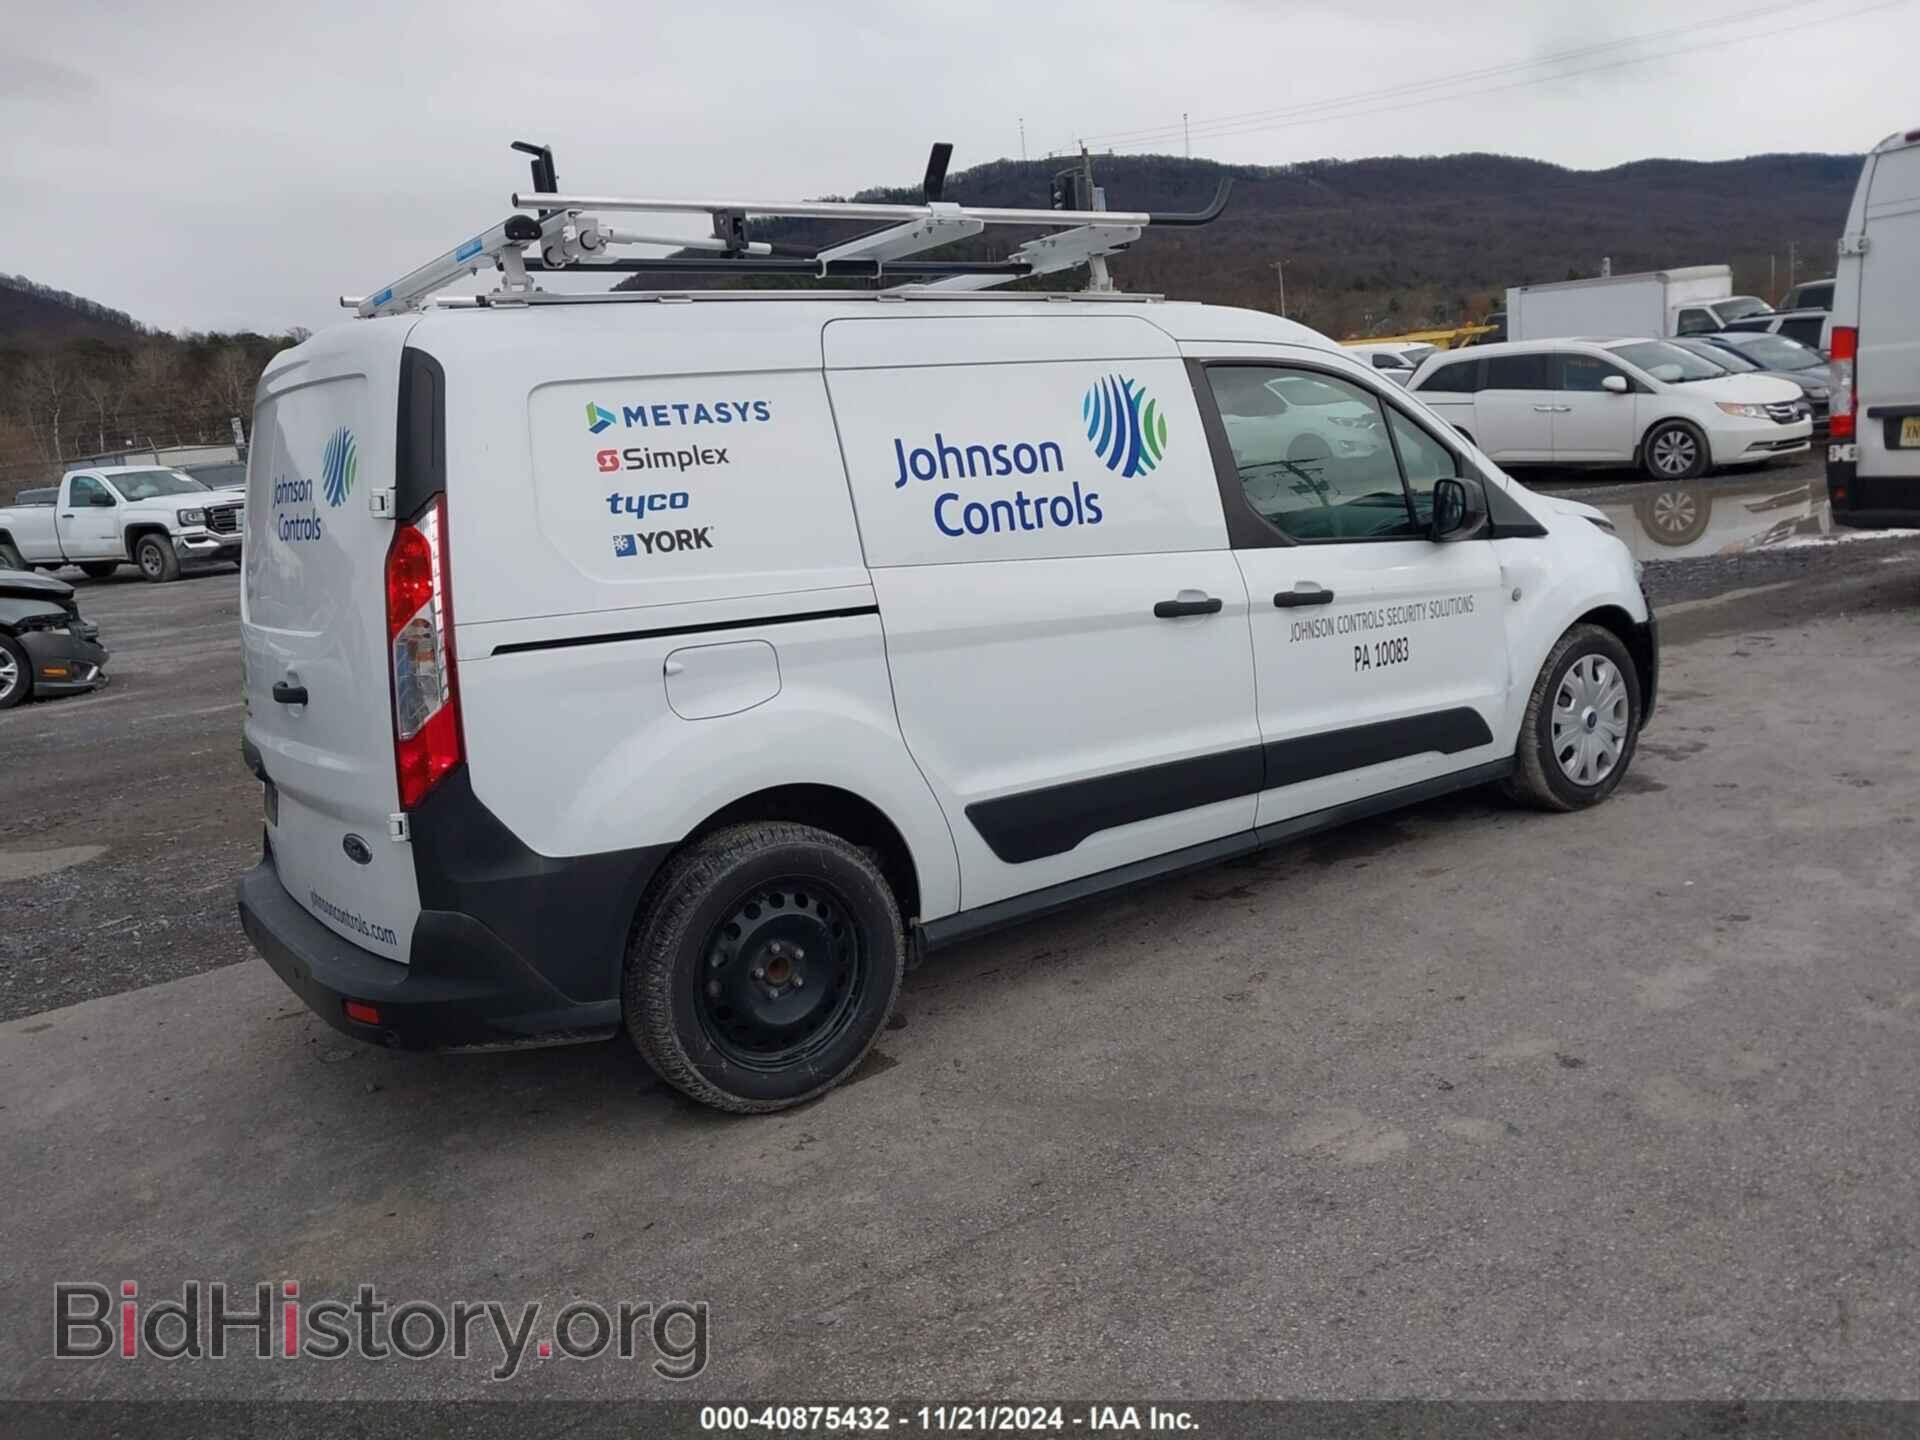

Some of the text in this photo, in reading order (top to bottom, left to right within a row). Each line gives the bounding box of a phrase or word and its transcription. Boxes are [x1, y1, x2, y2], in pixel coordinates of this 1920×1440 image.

[622, 401, 770, 427] METASYS
[623, 445, 730, 472] Simplex
[894, 433, 1064, 488] Johnson
[272, 473, 313, 508] Johnson
[606, 492, 689, 519] tyco
[278, 507, 321, 541] Controls
[934, 481, 1103, 537] Controls
[637, 527, 713, 554] YORK
[1289, 595, 1474, 643] JOHNSON CONTROLS SECURITY SOLUTIONS
[1354, 637, 1409, 672] PA 10083
